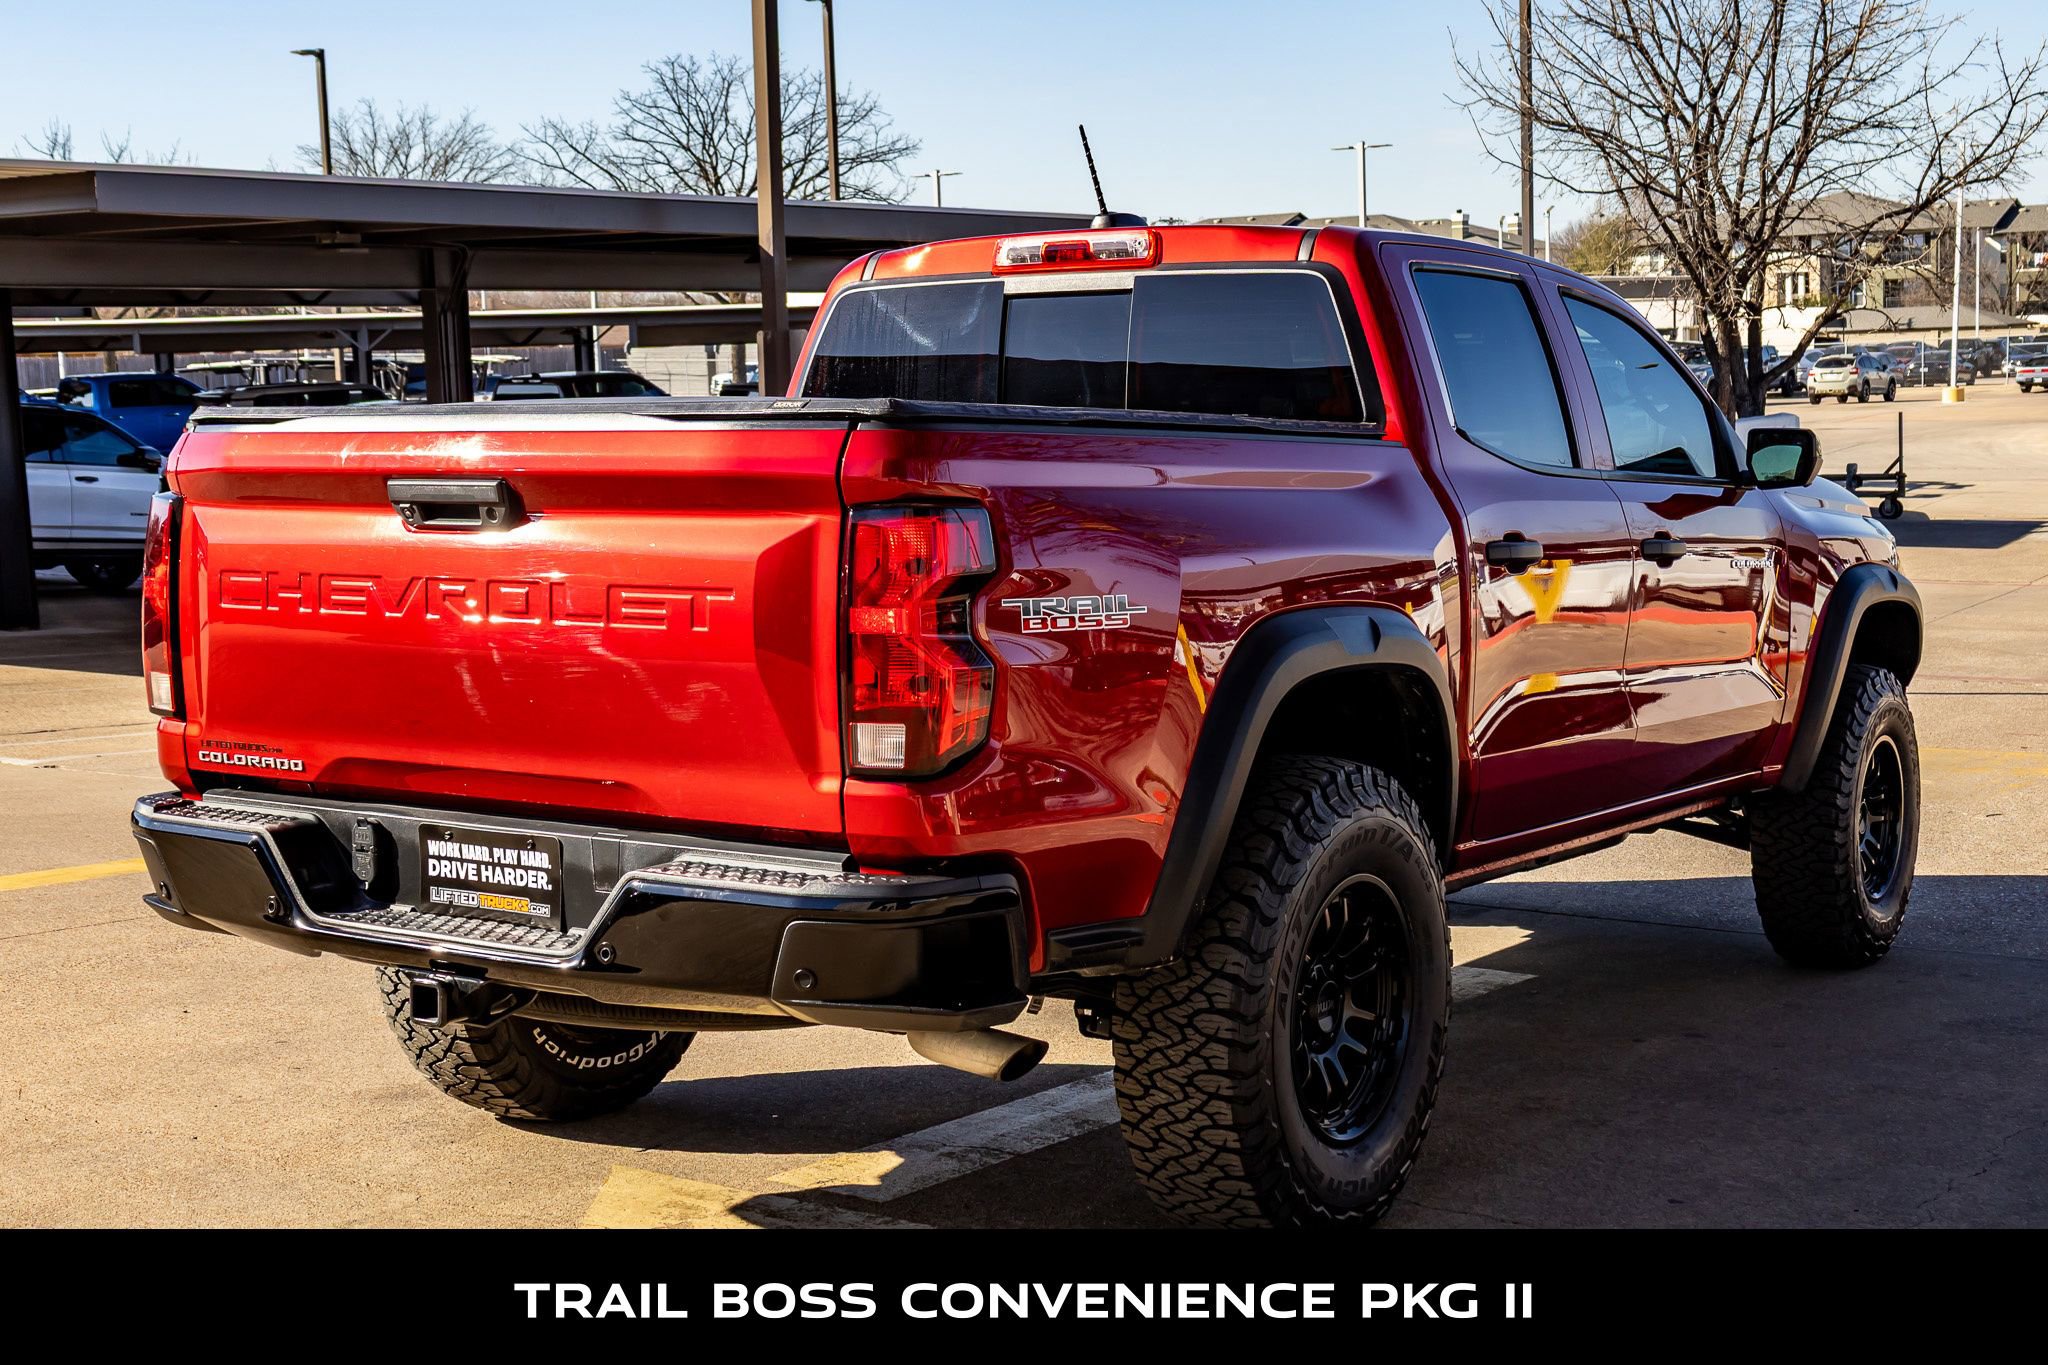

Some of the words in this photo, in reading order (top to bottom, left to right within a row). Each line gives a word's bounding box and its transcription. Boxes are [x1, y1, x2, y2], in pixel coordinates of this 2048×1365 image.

[219, 569, 736, 632] CHEVROLET
[1002, 595, 1147, 617] TRAIL
[1022, 613, 1131, 634] BOSS
[198, 750, 304, 771] COLORADO
[427, 839, 461, 858] WORK
[461, 843, 493, 862] HARD.
[493, 847, 518, 865] PLAY
[520, 850, 552, 869] HARD.
[428, 858, 478, 881] DRIVE
[481, 864, 552, 890] HARDER.
